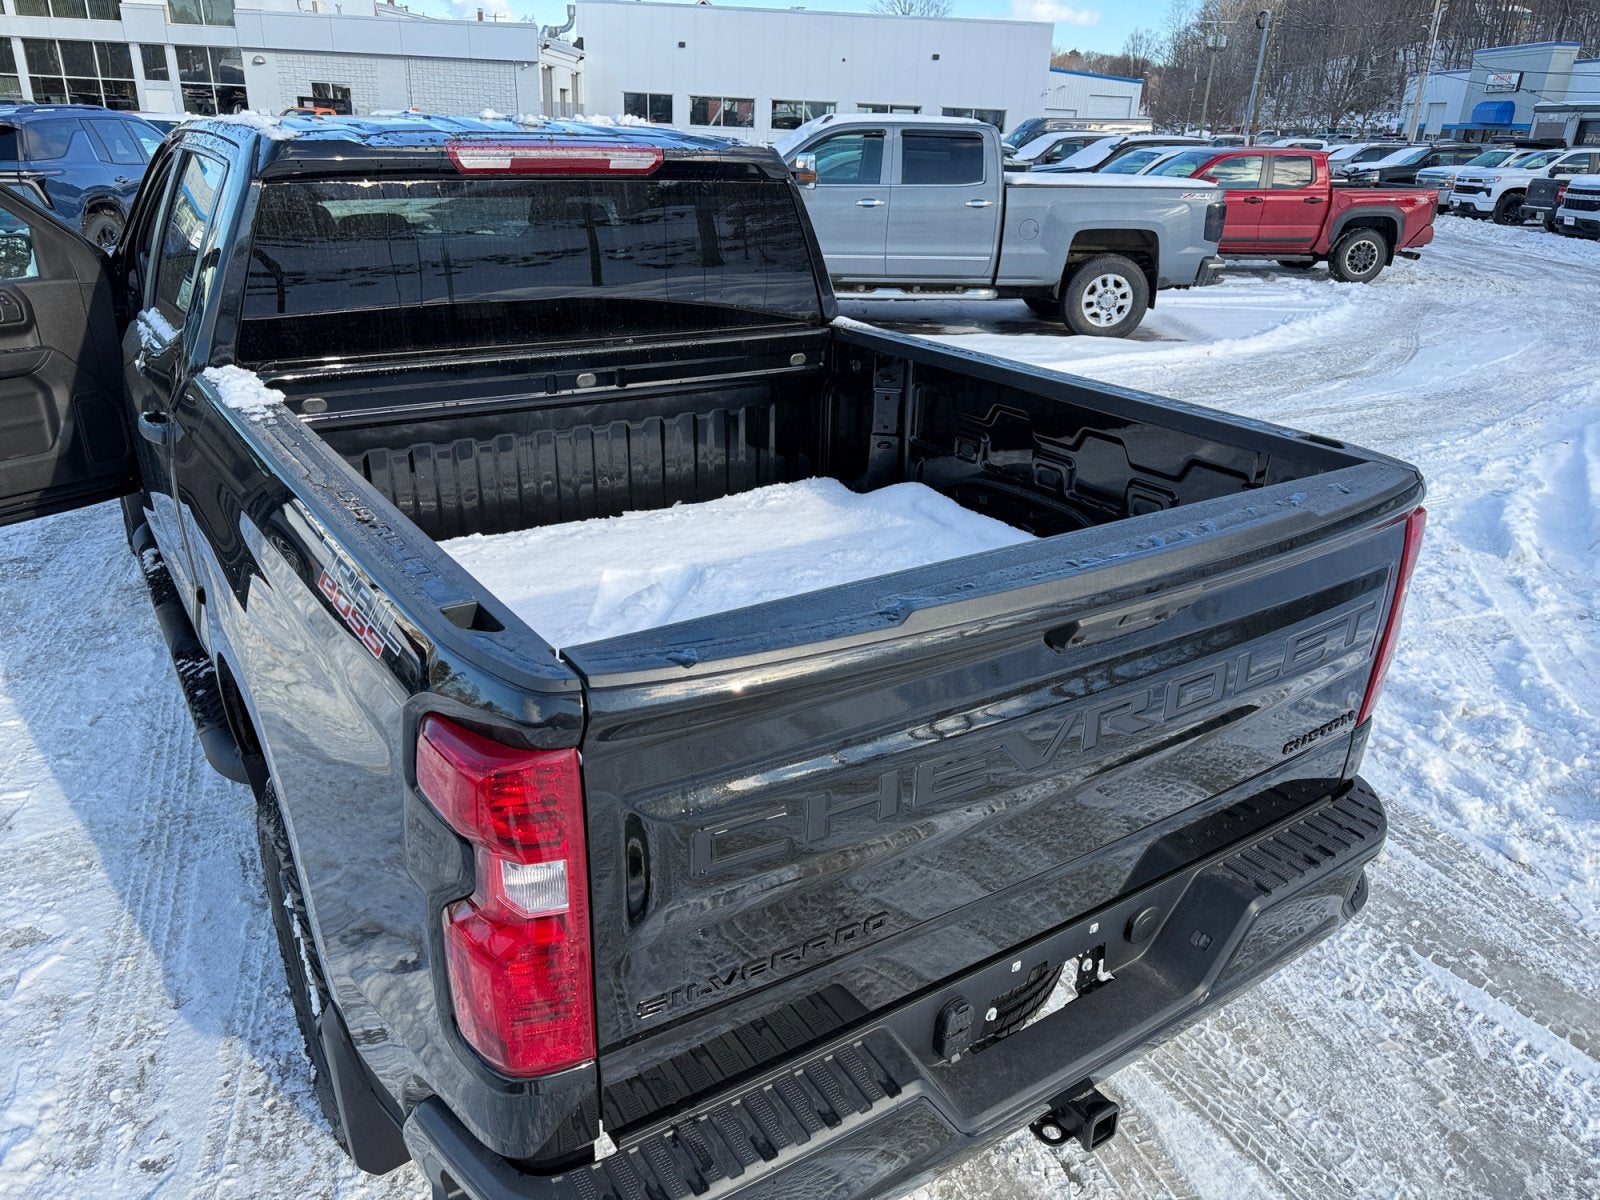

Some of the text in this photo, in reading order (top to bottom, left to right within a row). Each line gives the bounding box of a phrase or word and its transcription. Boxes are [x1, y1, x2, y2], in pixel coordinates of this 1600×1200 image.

[317, 570, 386, 660] BOSS
[321, 537, 402, 657] TRAIL
[690, 601, 1377, 878] CHEVROLET
[1282, 709, 1357, 755] CUSTOM
[636, 910, 890, 1020] SILVERADO
